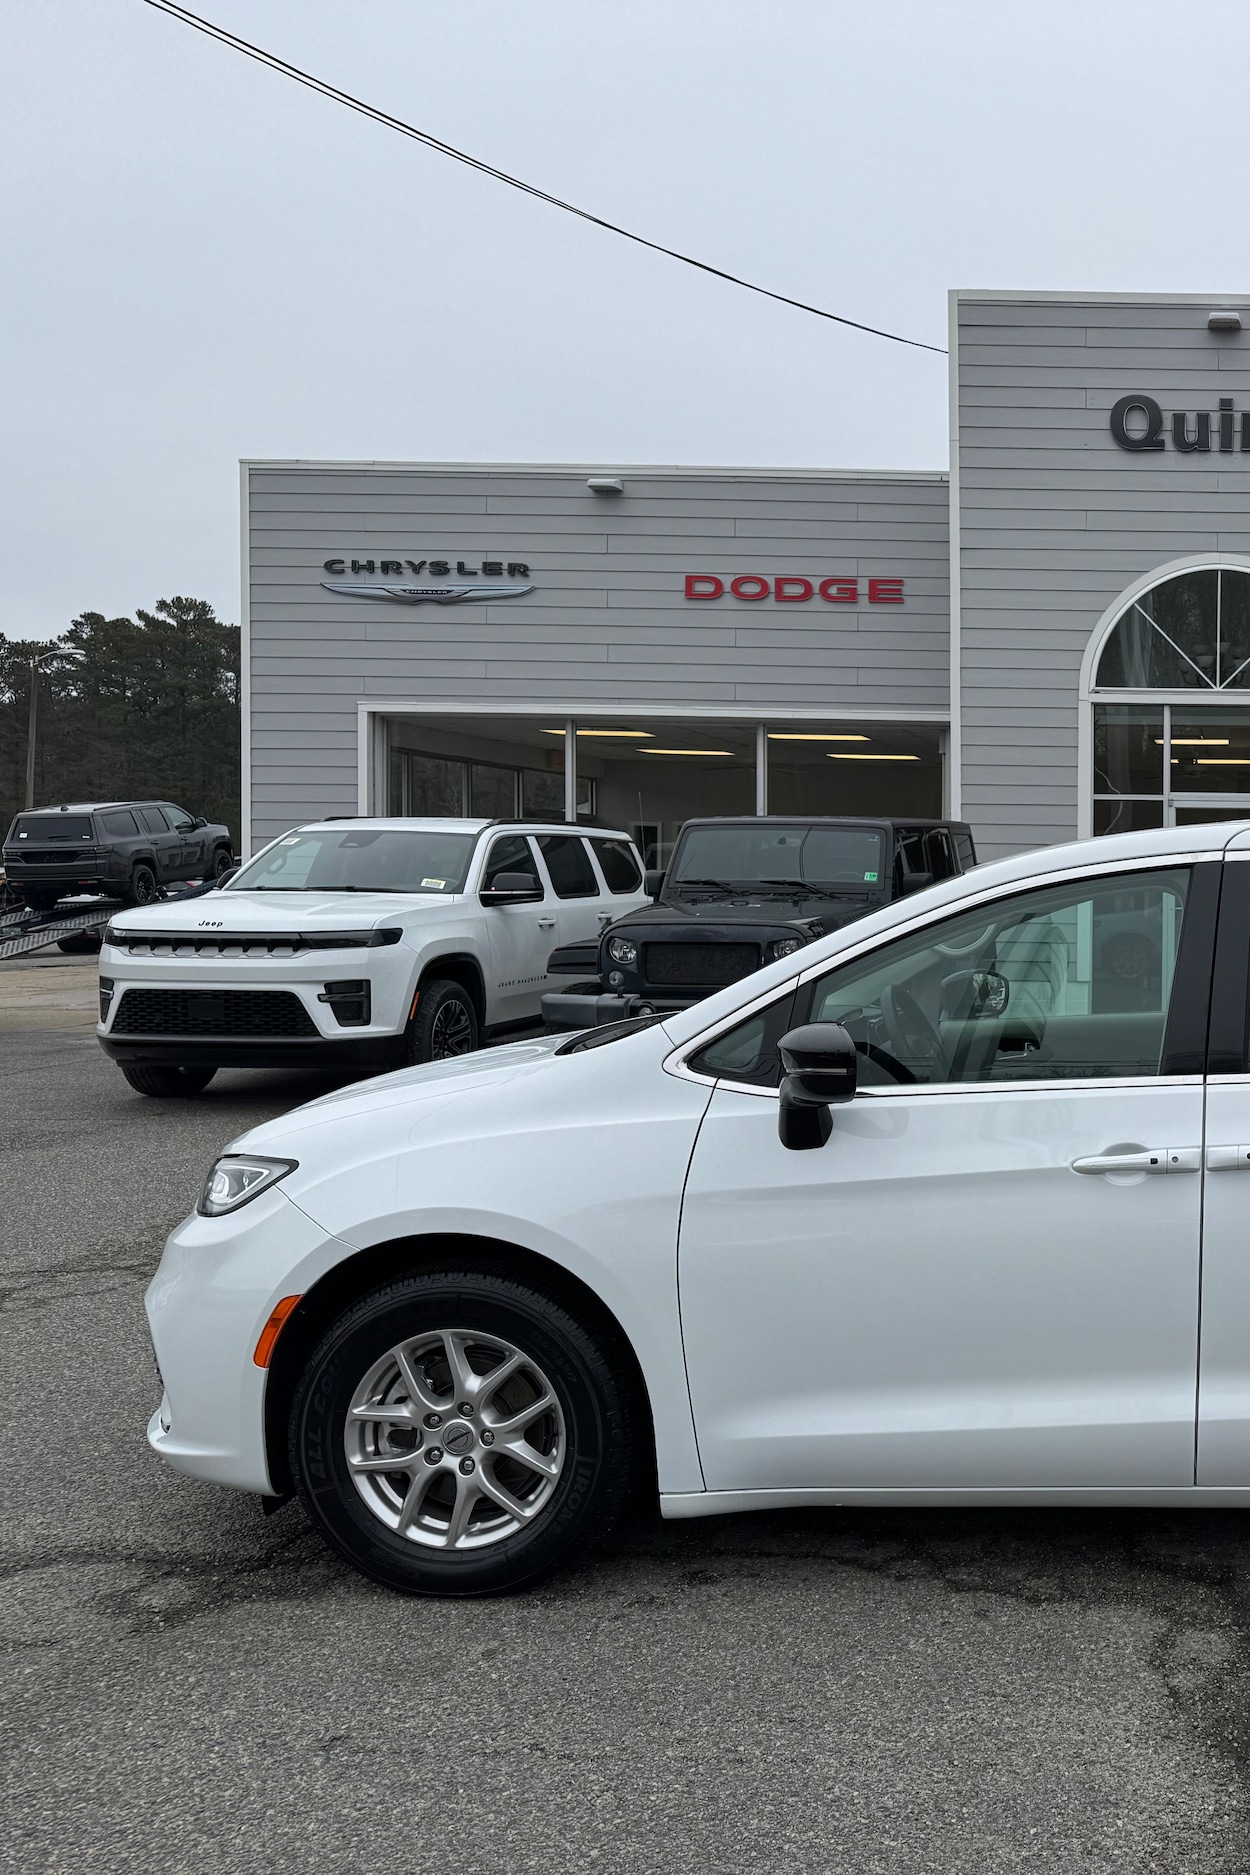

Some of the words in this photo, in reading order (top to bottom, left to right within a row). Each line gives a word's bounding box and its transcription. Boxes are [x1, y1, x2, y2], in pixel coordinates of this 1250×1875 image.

[323, 559, 530, 577] CHRYSLER
[684, 574, 905, 604] DODGE
[198, 919, 224, 928] Jeep
